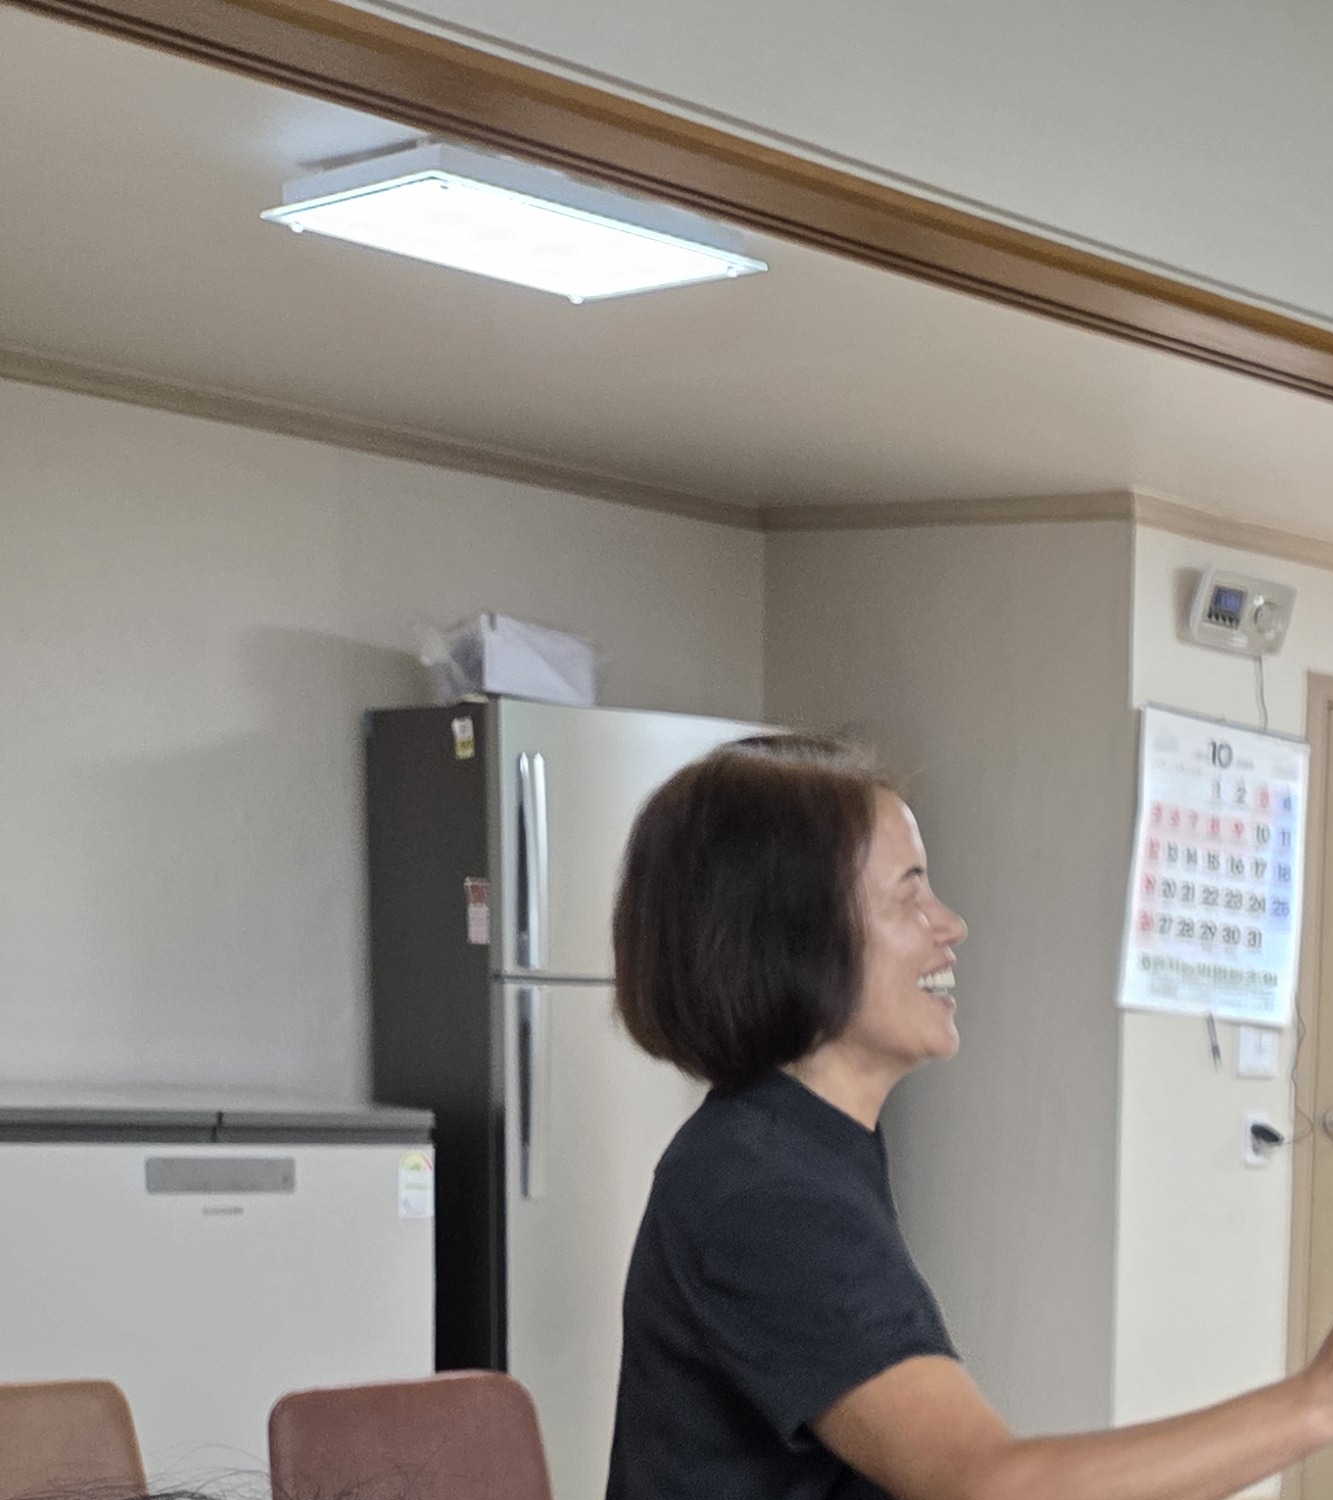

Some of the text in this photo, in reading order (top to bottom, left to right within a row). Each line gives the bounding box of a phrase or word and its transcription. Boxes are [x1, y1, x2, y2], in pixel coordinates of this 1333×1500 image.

[1209, 740, 1234, 769] 10
[1236, 786, 1247, 804] 2
[1256, 823, 1271, 844] 10
[1230, 856, 1244, 875] 16
[1254, 858, 1267, 878] 17
[1278, 864, 1291, 882] 18
[1162, 879, 1177, 899] 20
[1181, 882, 1195, 902] 21
[1202, 887, 1219, 906] 22
[1249, 893, 1266, 913] 24
[1159, 916, 1173, 935] 27
[1178, 919, 1194, 938] 28
[1200, 921, 1217, 940] 29
[1222, 925, 1241, 945] 30
[1248, 930, 1262, 949] 31
